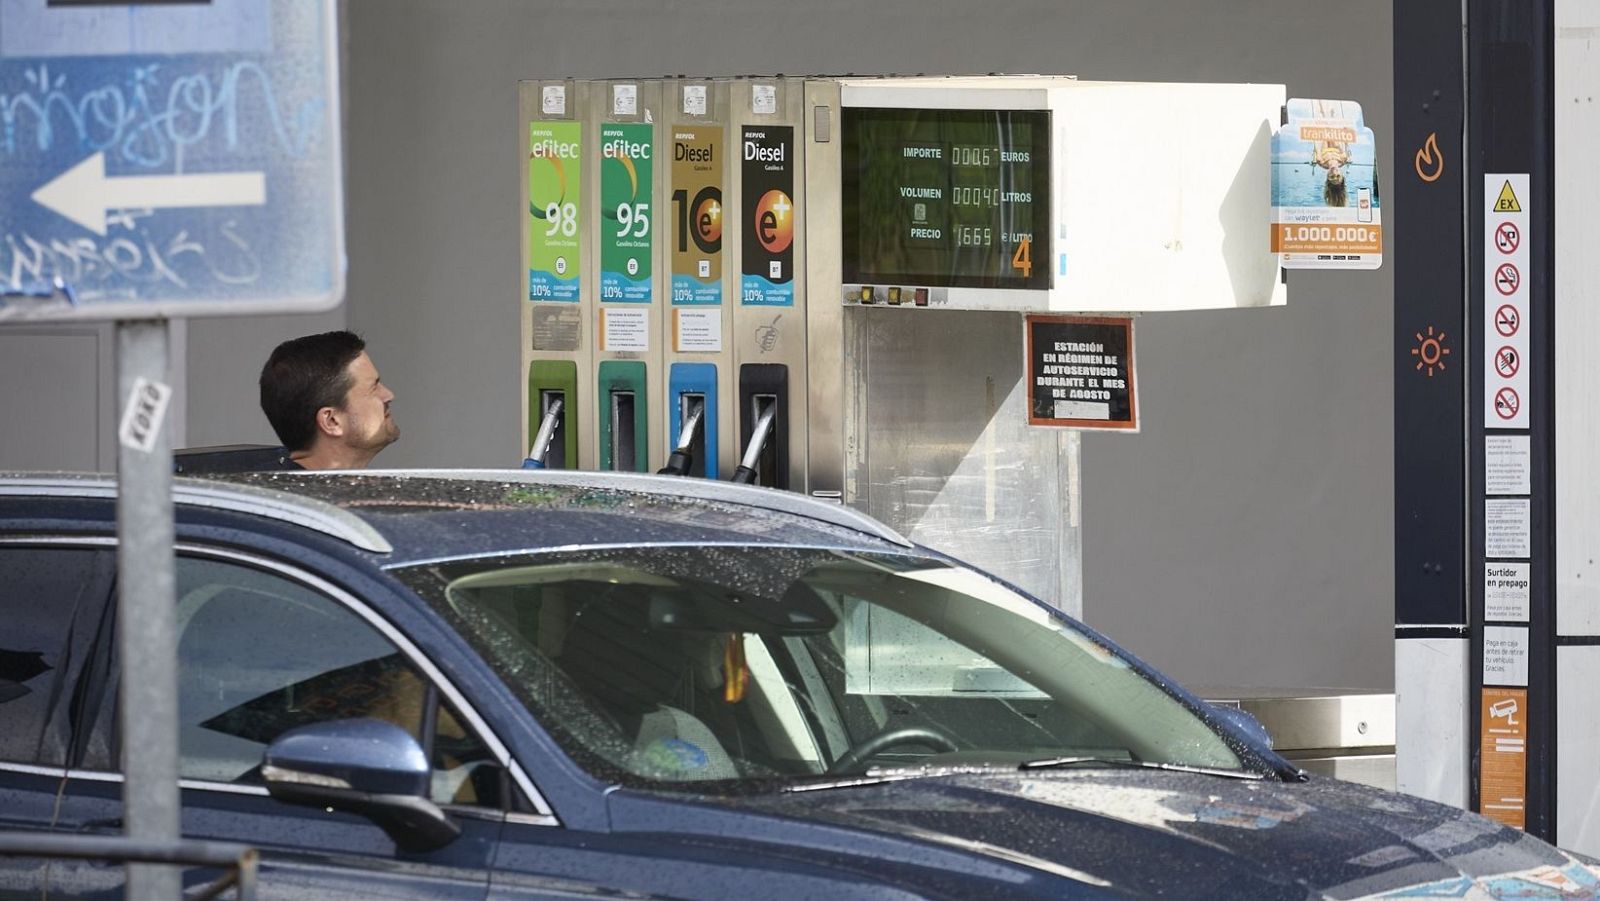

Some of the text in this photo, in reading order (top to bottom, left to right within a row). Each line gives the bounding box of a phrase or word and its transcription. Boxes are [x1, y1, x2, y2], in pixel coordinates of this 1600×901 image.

[532, 140, 578, 160] efitec
[603, 140, 650, 160] efitec
[674, 142, 713, 162] Diesel
[744, 141, 784, 162] Diesel
[904, 147, 942, 158] IMPORTE
[1001, 152, 1030, 162] EUROS
[900, 187, 942, 199] VOLUMEN
[1001, 192, 1032, 202] LITROS
[1500, 200, 1514, 209] EX
[546, 202, 577, 237] 98
[616, 202, 649, 238] 95
[911, 228, 941, 239] PRECIO
[1012, 238, 1032, 277] 4
[533, 285, 551, 296] 10%
[604, 286, 622, 298] 10%
[674, 289, 693, 300] 10%
[744, 290, 764, 301] 10%
[1054, 342, 1103, 352] ESTACIÓN
[1043, 353, 1117, 365] EN RÉGIMEN DE
[1043, 365, 1118, 376] AUTOSERVICIO
[1037, 377, 1125, 388] DURANTE EL MES
[1052, 389, 1110, 400] DE AGOSTO
[1499, 580, 1527, 589] prepago
